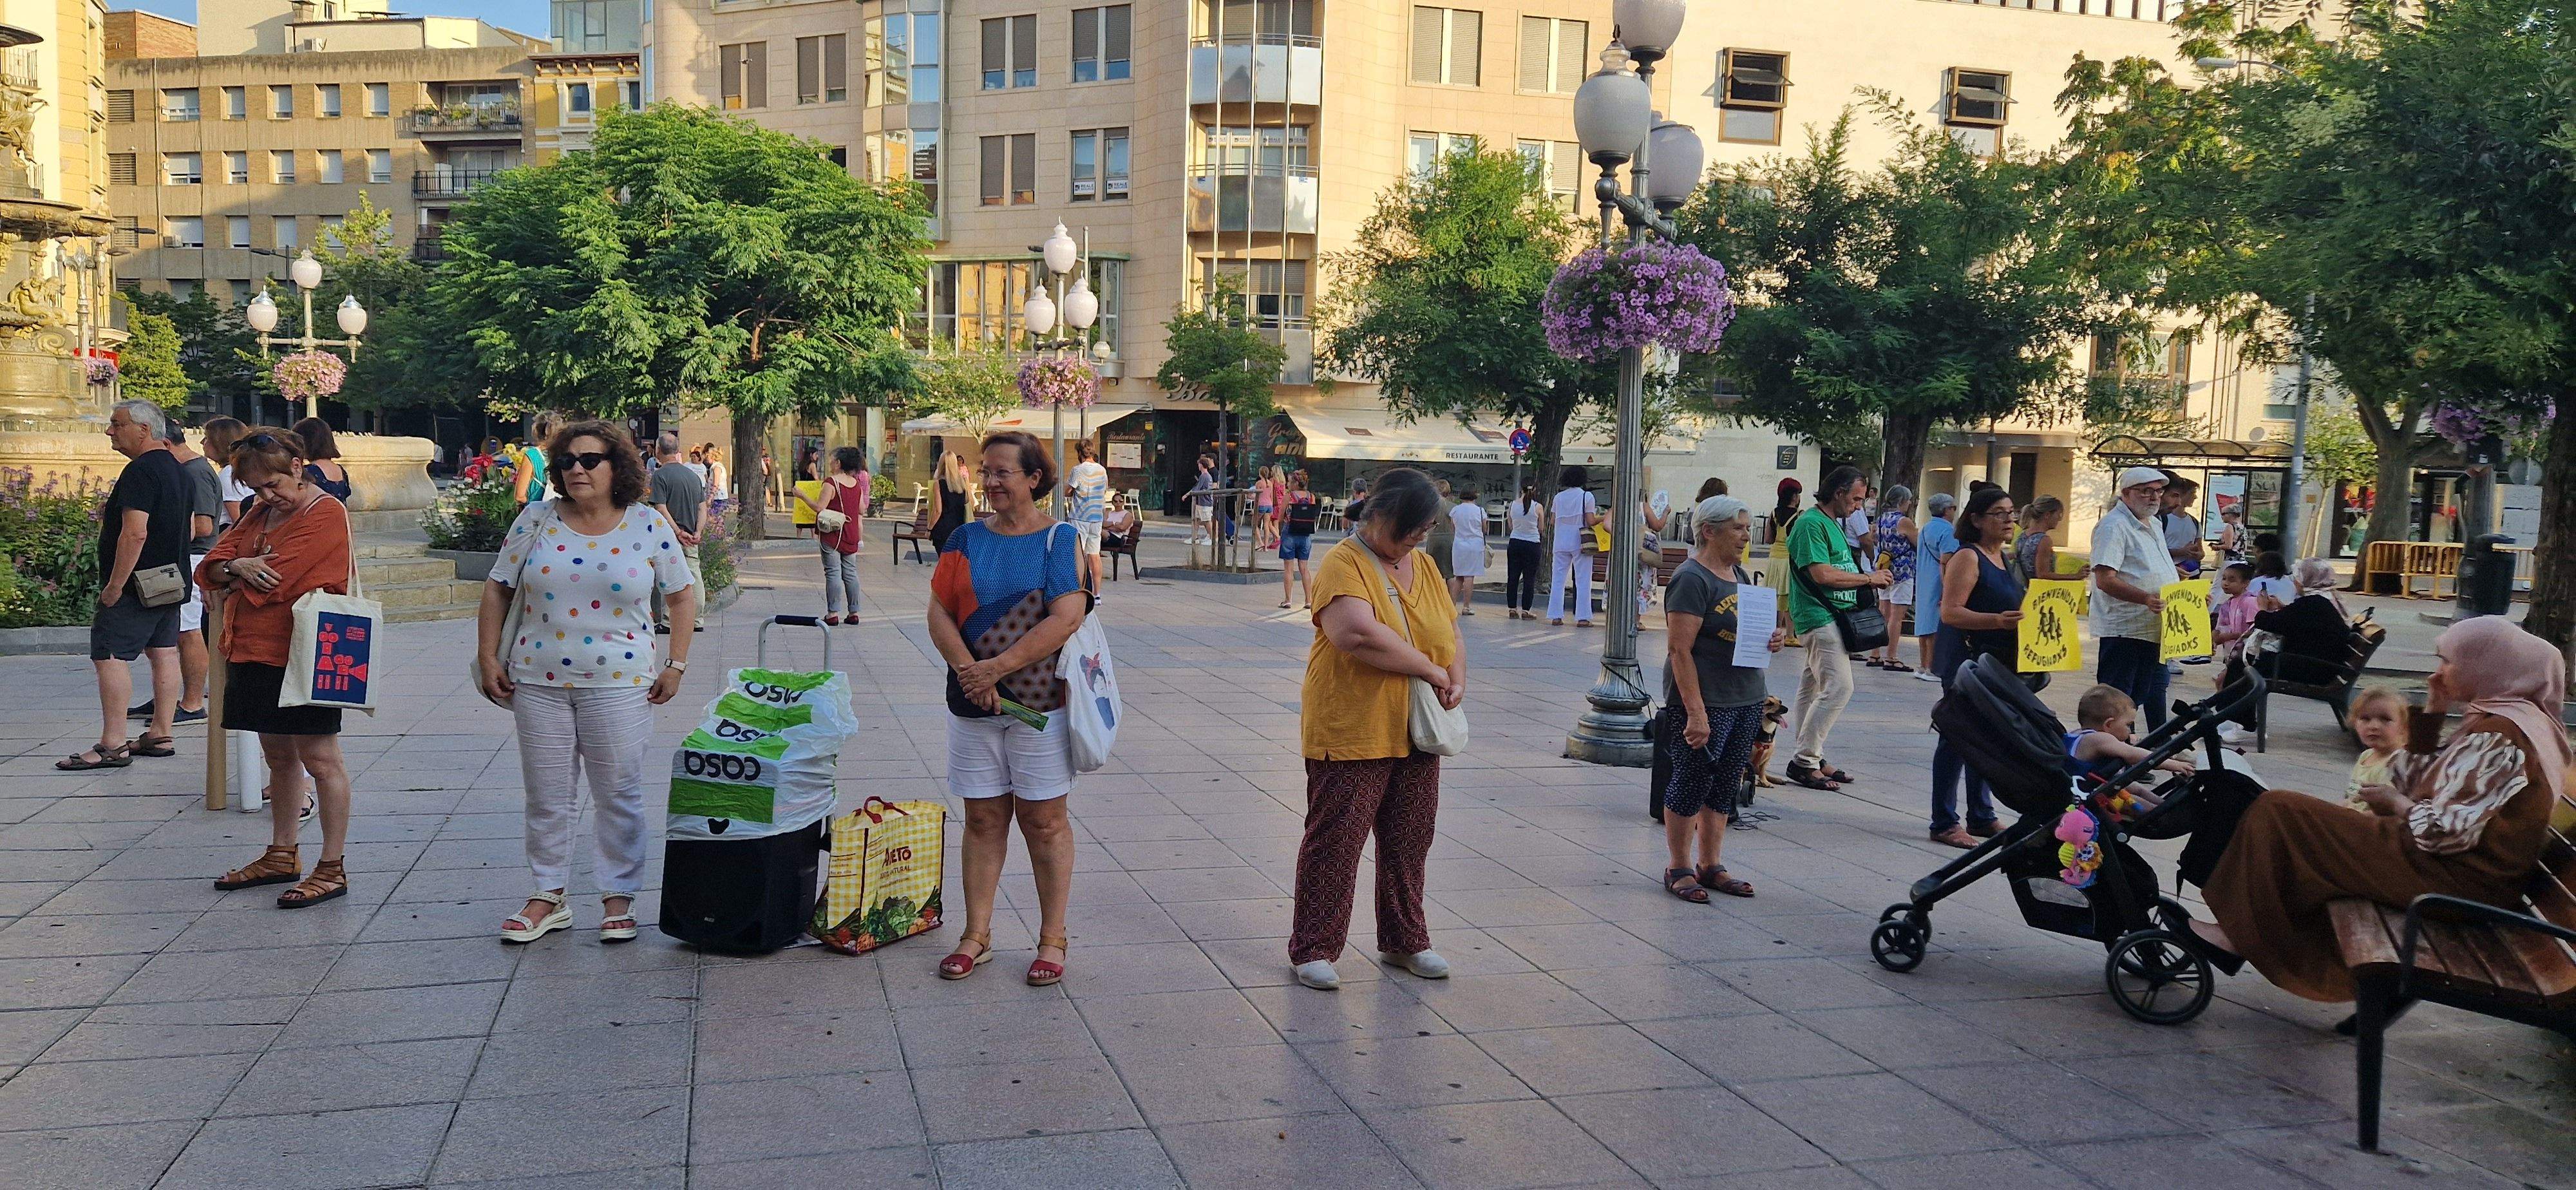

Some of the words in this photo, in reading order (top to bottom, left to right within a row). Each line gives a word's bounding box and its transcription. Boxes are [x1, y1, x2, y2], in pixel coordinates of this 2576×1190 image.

[1166, 381, 1211, 401] Bo
[1714, 594, 1738, 615] REFU
[2166, 589, 2202, 609] ENVENIDXS
[2164, 637, 2199, 655] UGIADXS
[684, 750, 761, 781] casa
